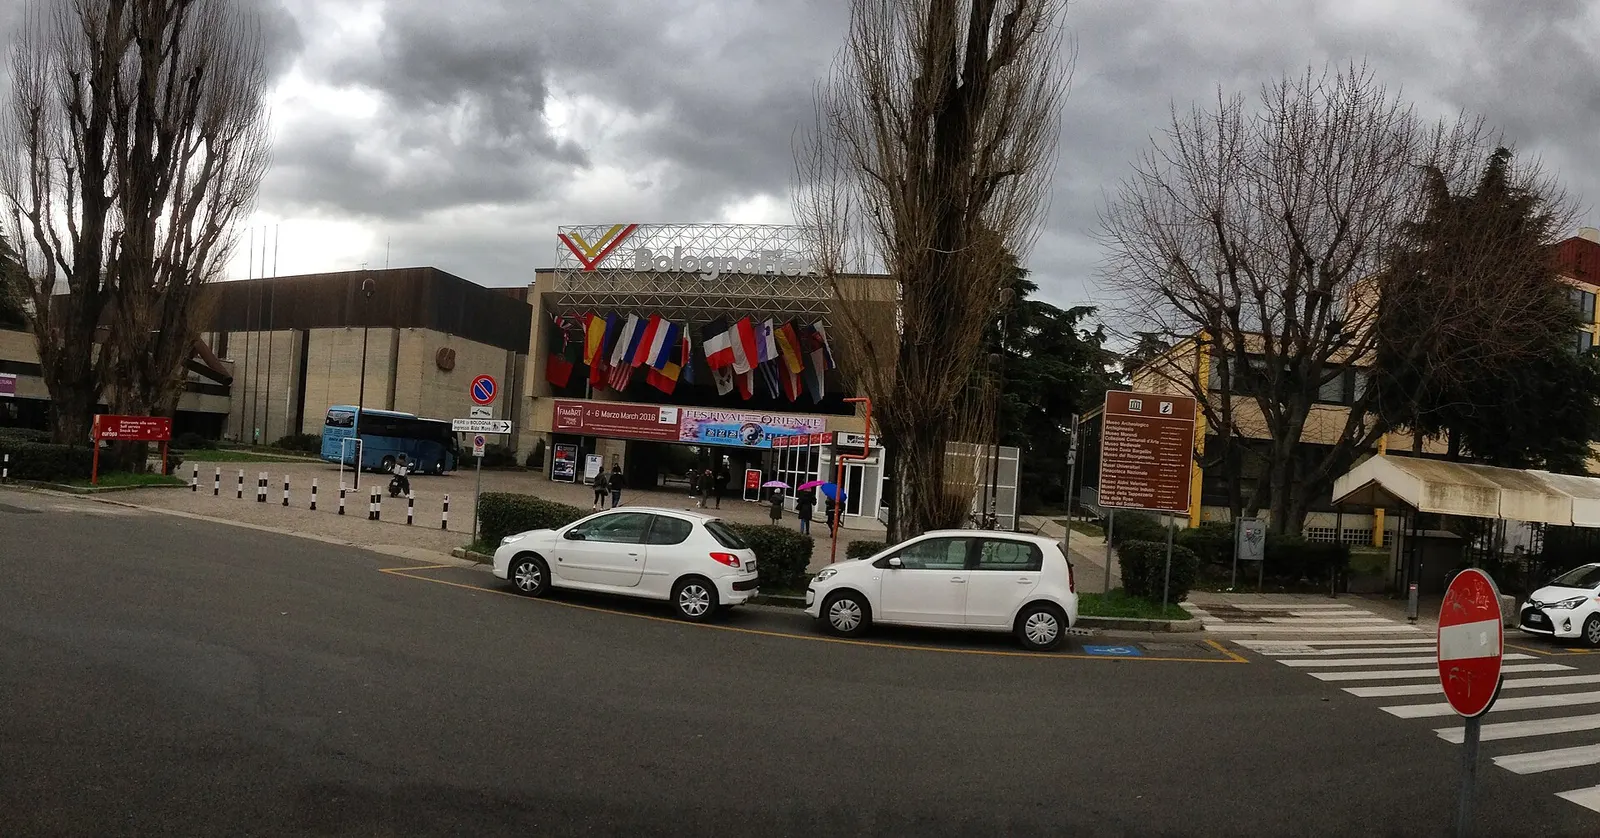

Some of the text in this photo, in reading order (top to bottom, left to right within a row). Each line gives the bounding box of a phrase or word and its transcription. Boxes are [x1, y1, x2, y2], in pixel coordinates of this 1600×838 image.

[634, 245, 810, 280] BolognaFier
[601, 411, 619, 419] Marzo
[620, 412, 639, 420] March
[639, 412, 656, 421] 2016
[685, 410, 743, 421] FESTIVAL
[761, 414, 821, 427] ORIENTE
